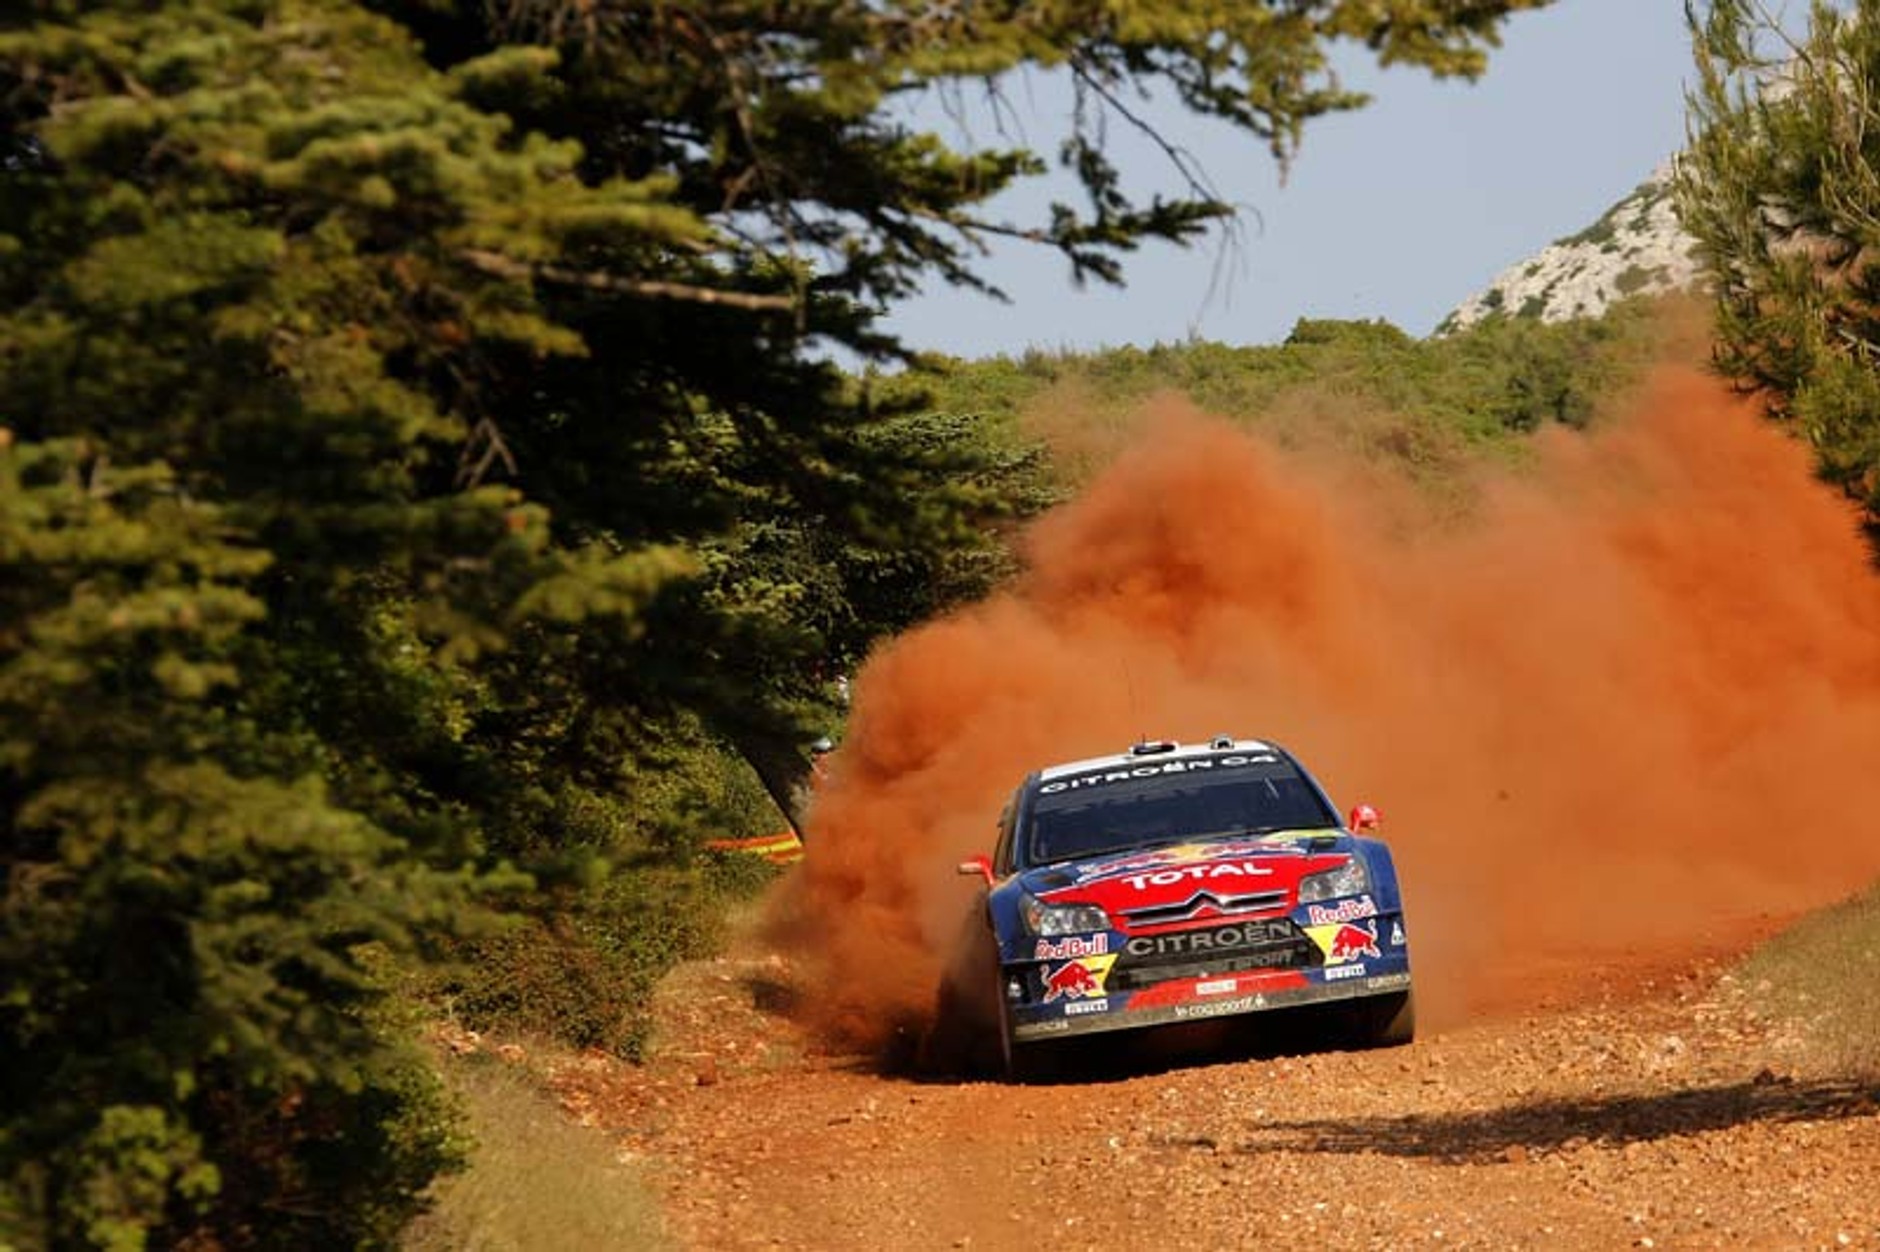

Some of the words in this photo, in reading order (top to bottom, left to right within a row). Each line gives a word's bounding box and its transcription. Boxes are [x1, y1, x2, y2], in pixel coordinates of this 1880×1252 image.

[1040, 760, 1212, 793] CITROËN
[1122, 862, 1274, 890] TOTAL
[1127, 920, 1292, 955] CITROËN
